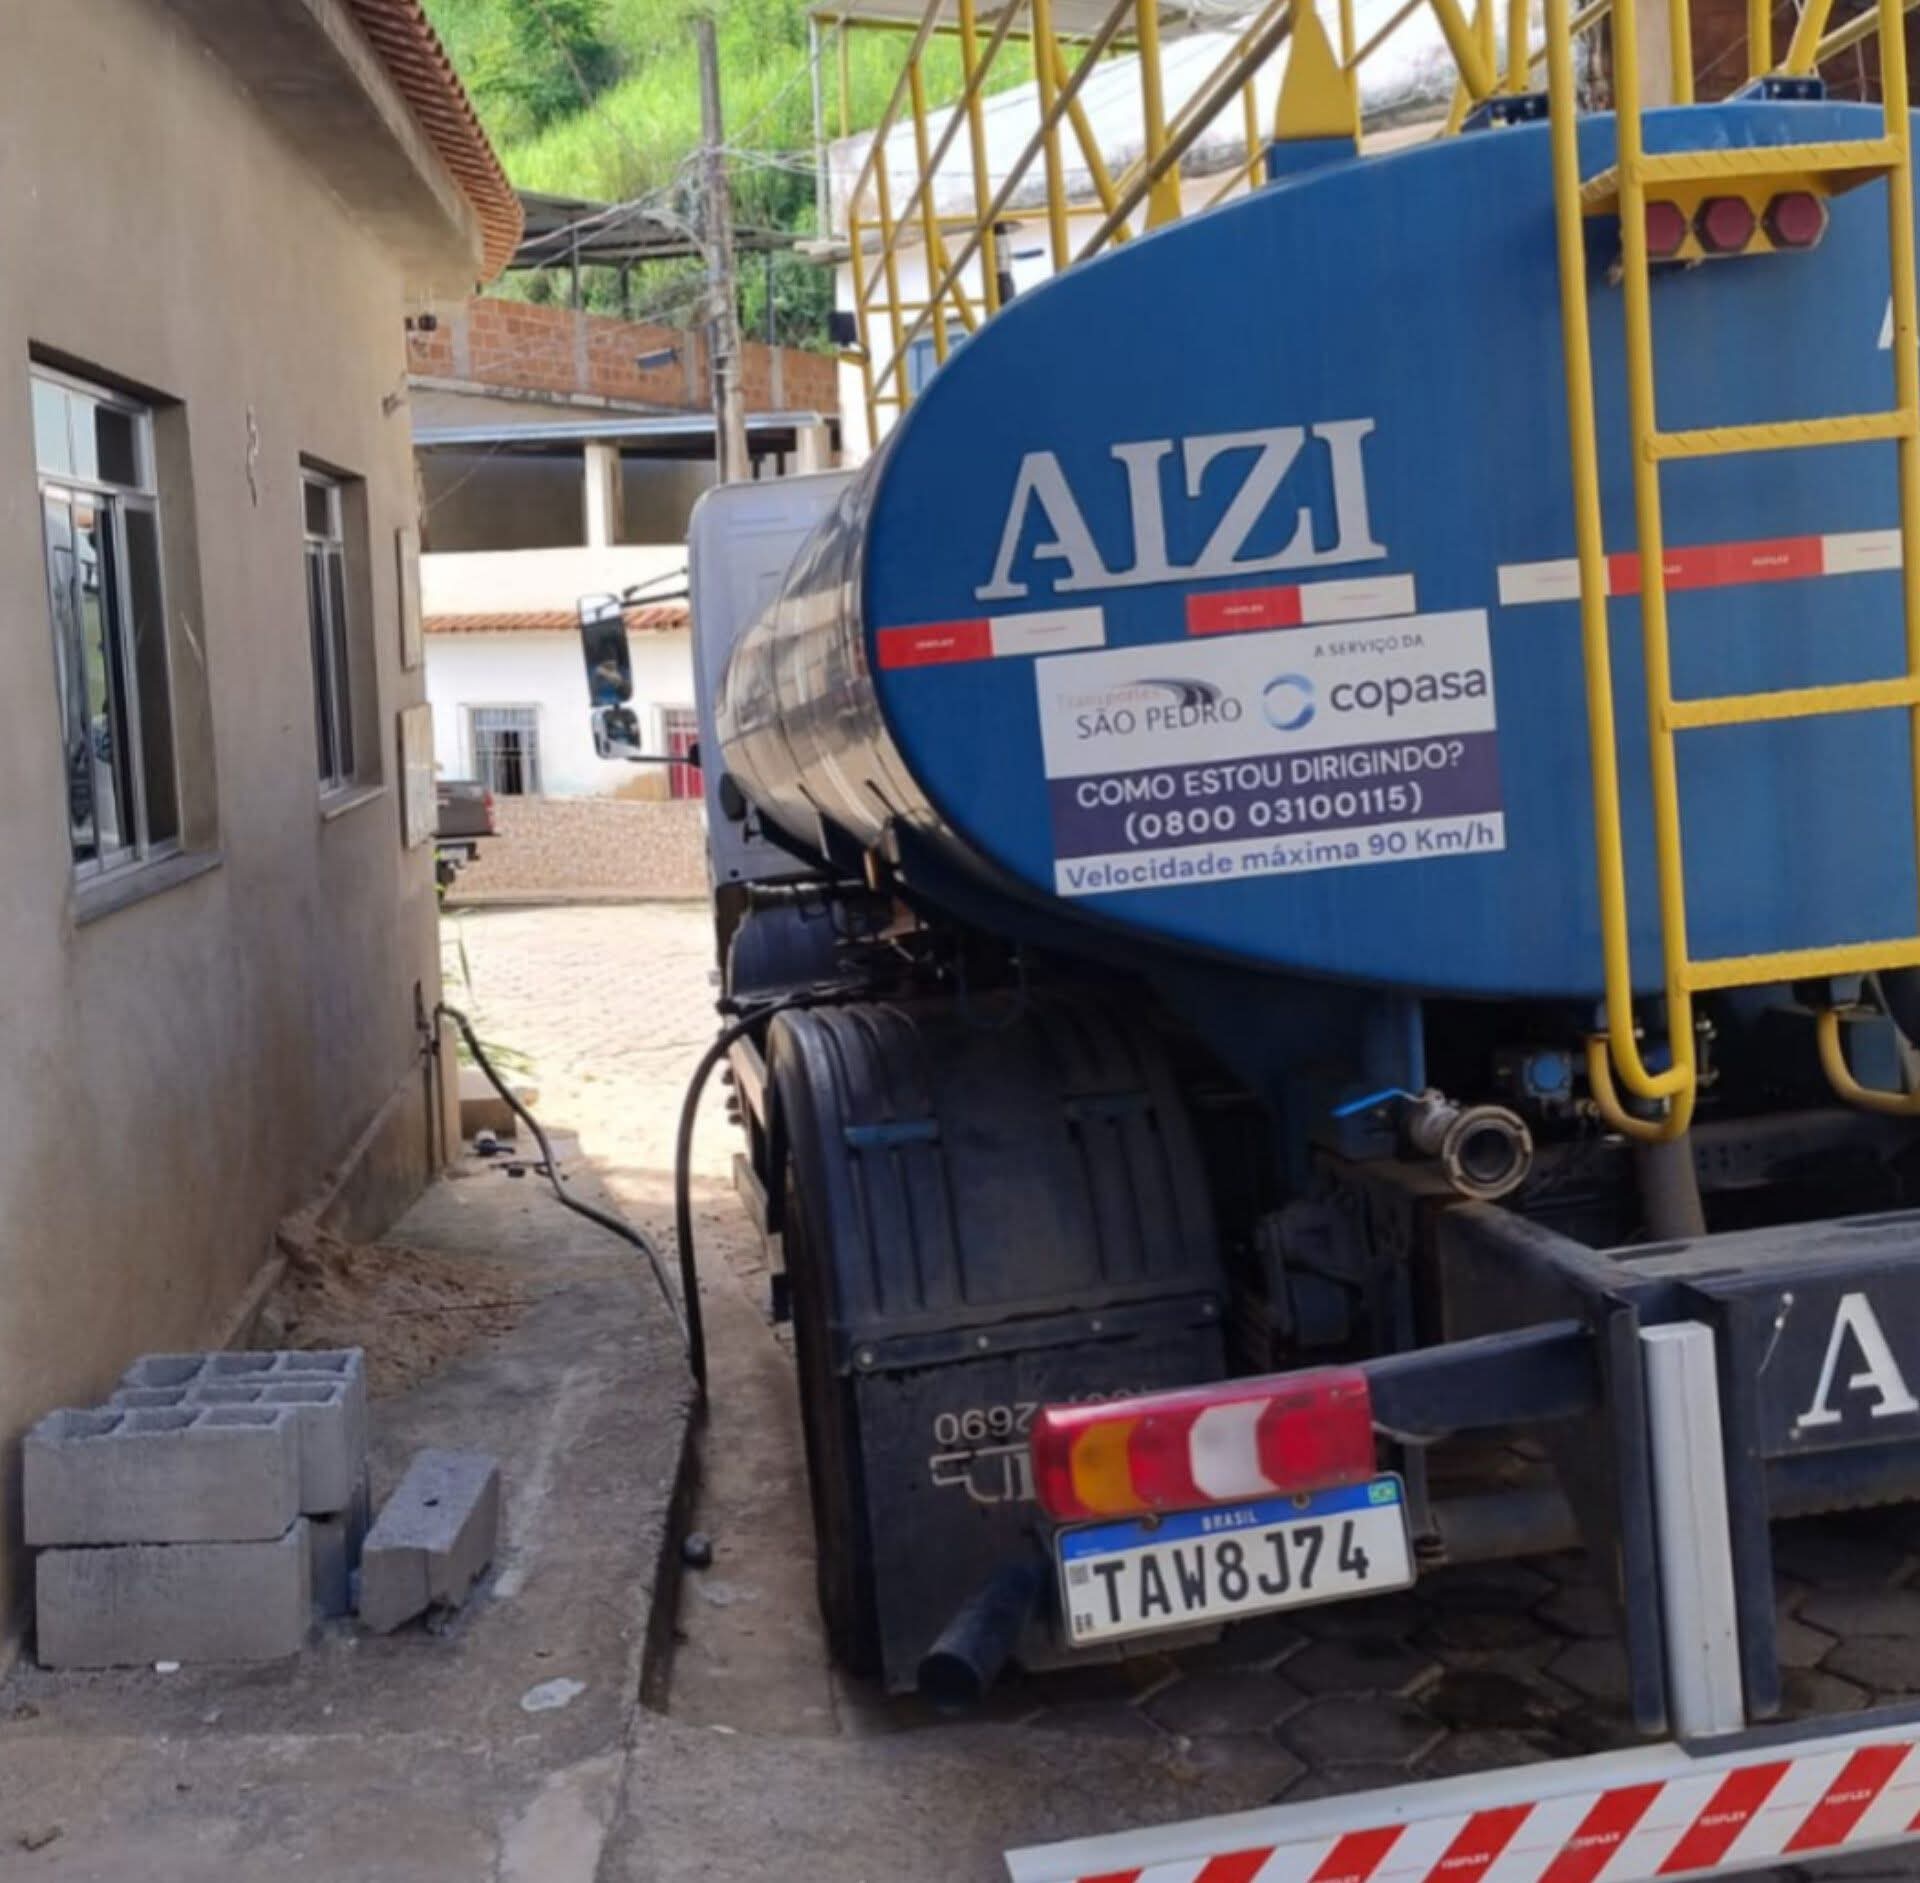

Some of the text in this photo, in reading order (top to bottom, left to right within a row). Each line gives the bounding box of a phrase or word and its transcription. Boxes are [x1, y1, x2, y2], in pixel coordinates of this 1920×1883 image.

[974, 417, 1388, 600] AIZI
[1313, 633, 1425, 658] A SERVIÇO DA
[1076, 697, 1243, 740] SÃO PEDRO
[1330, 668, 1488, 717] copasa
[1076, 740, 1464, 808] COMO ESTOU DIRIGINDO?
[1124, 780, 1423, 845] (0800 03100115)
[1066, 819, 1494, 889] Velocidade máxima 90 Km/h
[1201, 1510, 1257, 1532] BRASIL
[1092, 1519, 1369, 1624] TAW8J74
